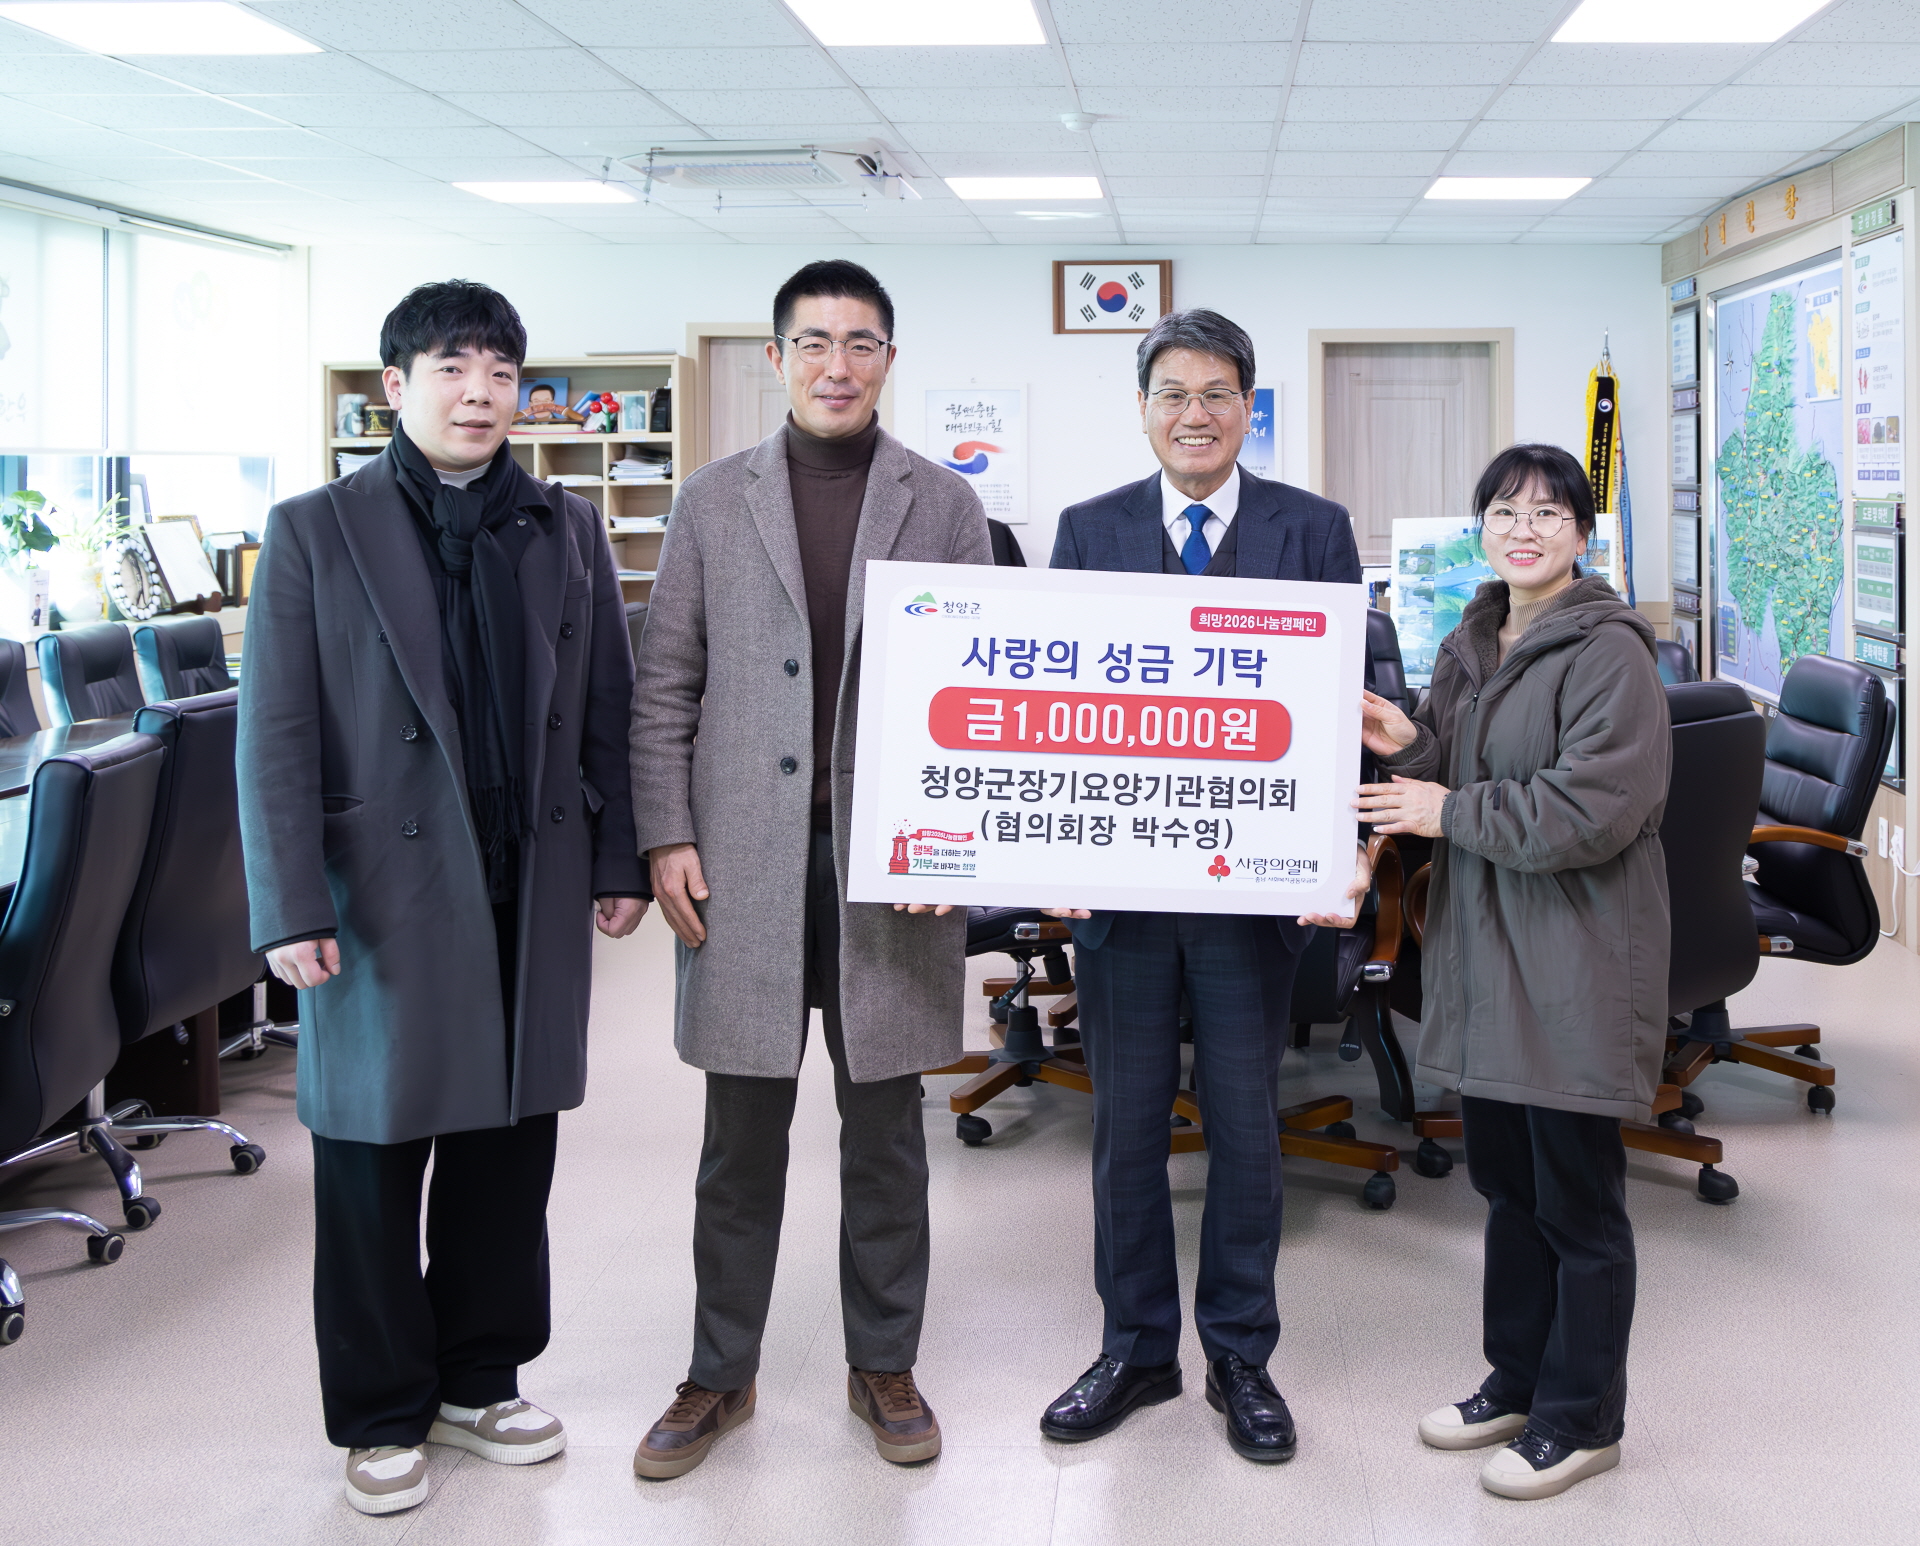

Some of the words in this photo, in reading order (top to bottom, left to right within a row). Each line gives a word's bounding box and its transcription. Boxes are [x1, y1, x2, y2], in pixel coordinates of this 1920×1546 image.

[988, 419, 1003, 433] 힘
[942, 601, 982, 615] 청양군
[1199, 613, 1317, 632] 희망2026나눔캠페인
[962, 637, 1079, 680] 사랑의
[1098, 643, 1175, 684] 성금
[1193, 647, 1268, 688] 기탁
[966, 698, 1258, 752] 금1,000,000원
[920, 765, 1297, 811] 청양군장기요양기관협의회
[980, 810, 1117, 846] (협의회장
[1132, 817, 1234, 849] 박수영)
[913, 845, 939, 856] 행복을
[941, 849, 961, 857] 더하는
[912, 859, 939, 869] 기부로
[940, 862, 960, 870] 바꾸는
[1235, 858, 1318, 875] 사랑의열매
